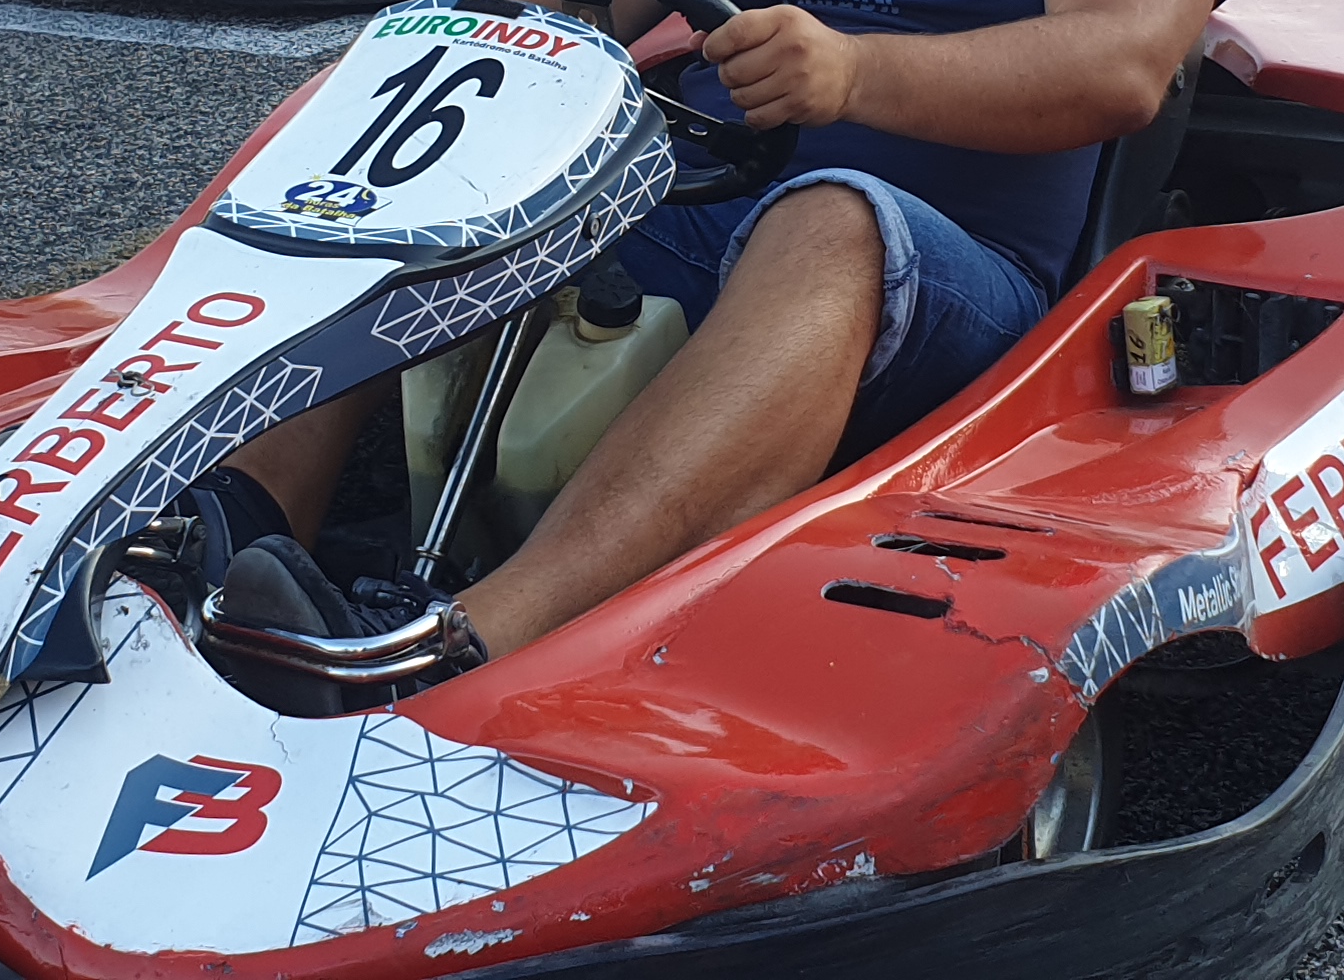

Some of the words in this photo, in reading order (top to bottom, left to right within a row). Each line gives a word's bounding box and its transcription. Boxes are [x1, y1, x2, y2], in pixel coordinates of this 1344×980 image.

[371, 14, 581, 58] EUROINDY
[452, 38, 512, 55] Kartódromo
[512, 49, 527, 59] da
[527, 52, 568, 72] Batalha
[327, 44, 506, 188] 16
[282, 202, 298, 210] da
[302, 204, 358, 220] Batalha
[294, 180, 359, 208] 24
[305, 197, 341, 209] horas
[1177, 573, 1232, 625] Metallic
